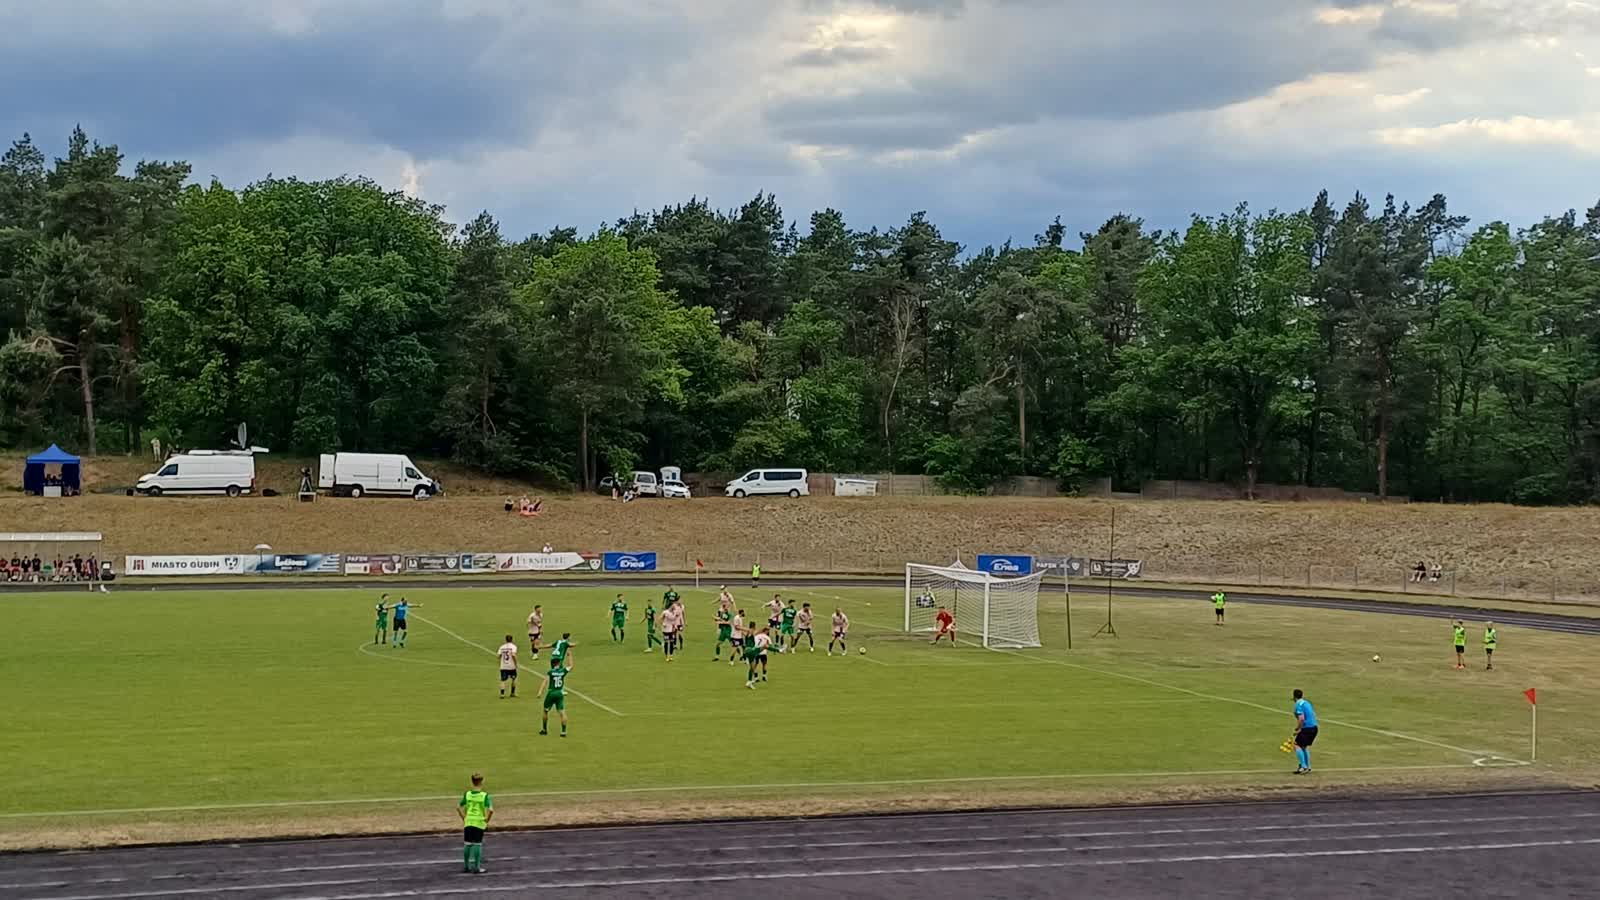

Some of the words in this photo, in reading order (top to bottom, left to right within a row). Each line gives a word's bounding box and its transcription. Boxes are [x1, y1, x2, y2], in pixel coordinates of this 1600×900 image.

[151, 561, 188, 570] MIASTO
[190, 561, 220, 569] GUBIN
[620, 560, 645, 568] Enea
[993, 563, 1019, 572] Enea
[553, 676, 562, 688] 16
